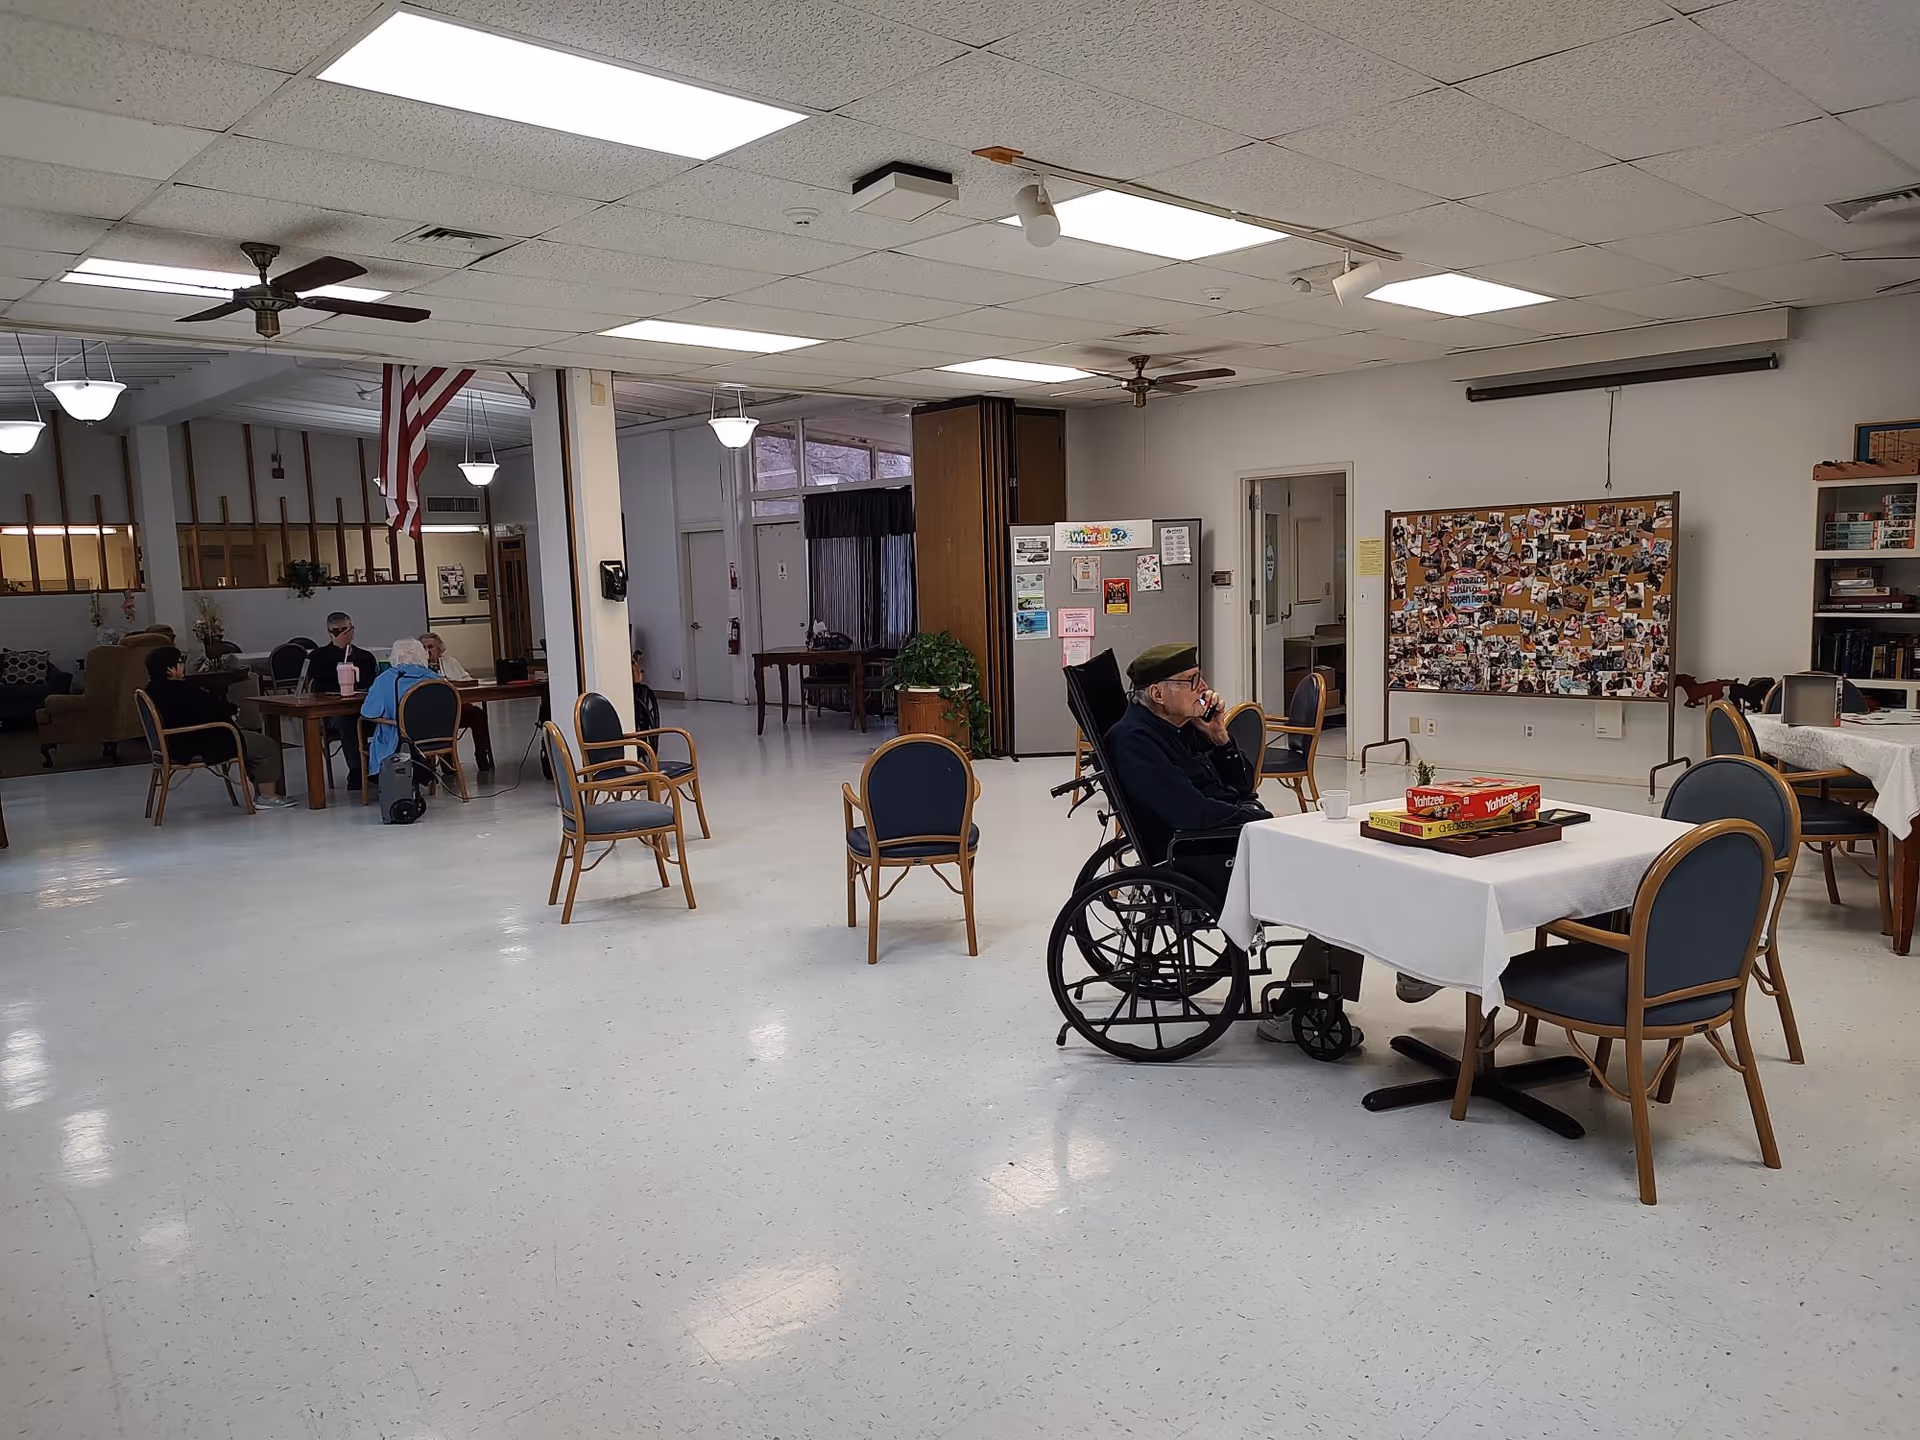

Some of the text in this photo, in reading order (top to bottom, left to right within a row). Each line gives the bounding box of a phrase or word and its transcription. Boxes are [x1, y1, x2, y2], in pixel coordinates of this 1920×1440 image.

[1071, 531, 1124, 542] What's Up?
[1448, 576, 1487, 586] Amazing
[1454, 585, 1482, 594] things
[1472, 593, 1487, 603] here
[1413, 795, 1445, 808] Yahtzee
[1485, 791, 1519, 813] Yahtzee
[1375, 816, 1400, 827] CHECKERS
[1438, 821, 1475, 834] CHECKERS
